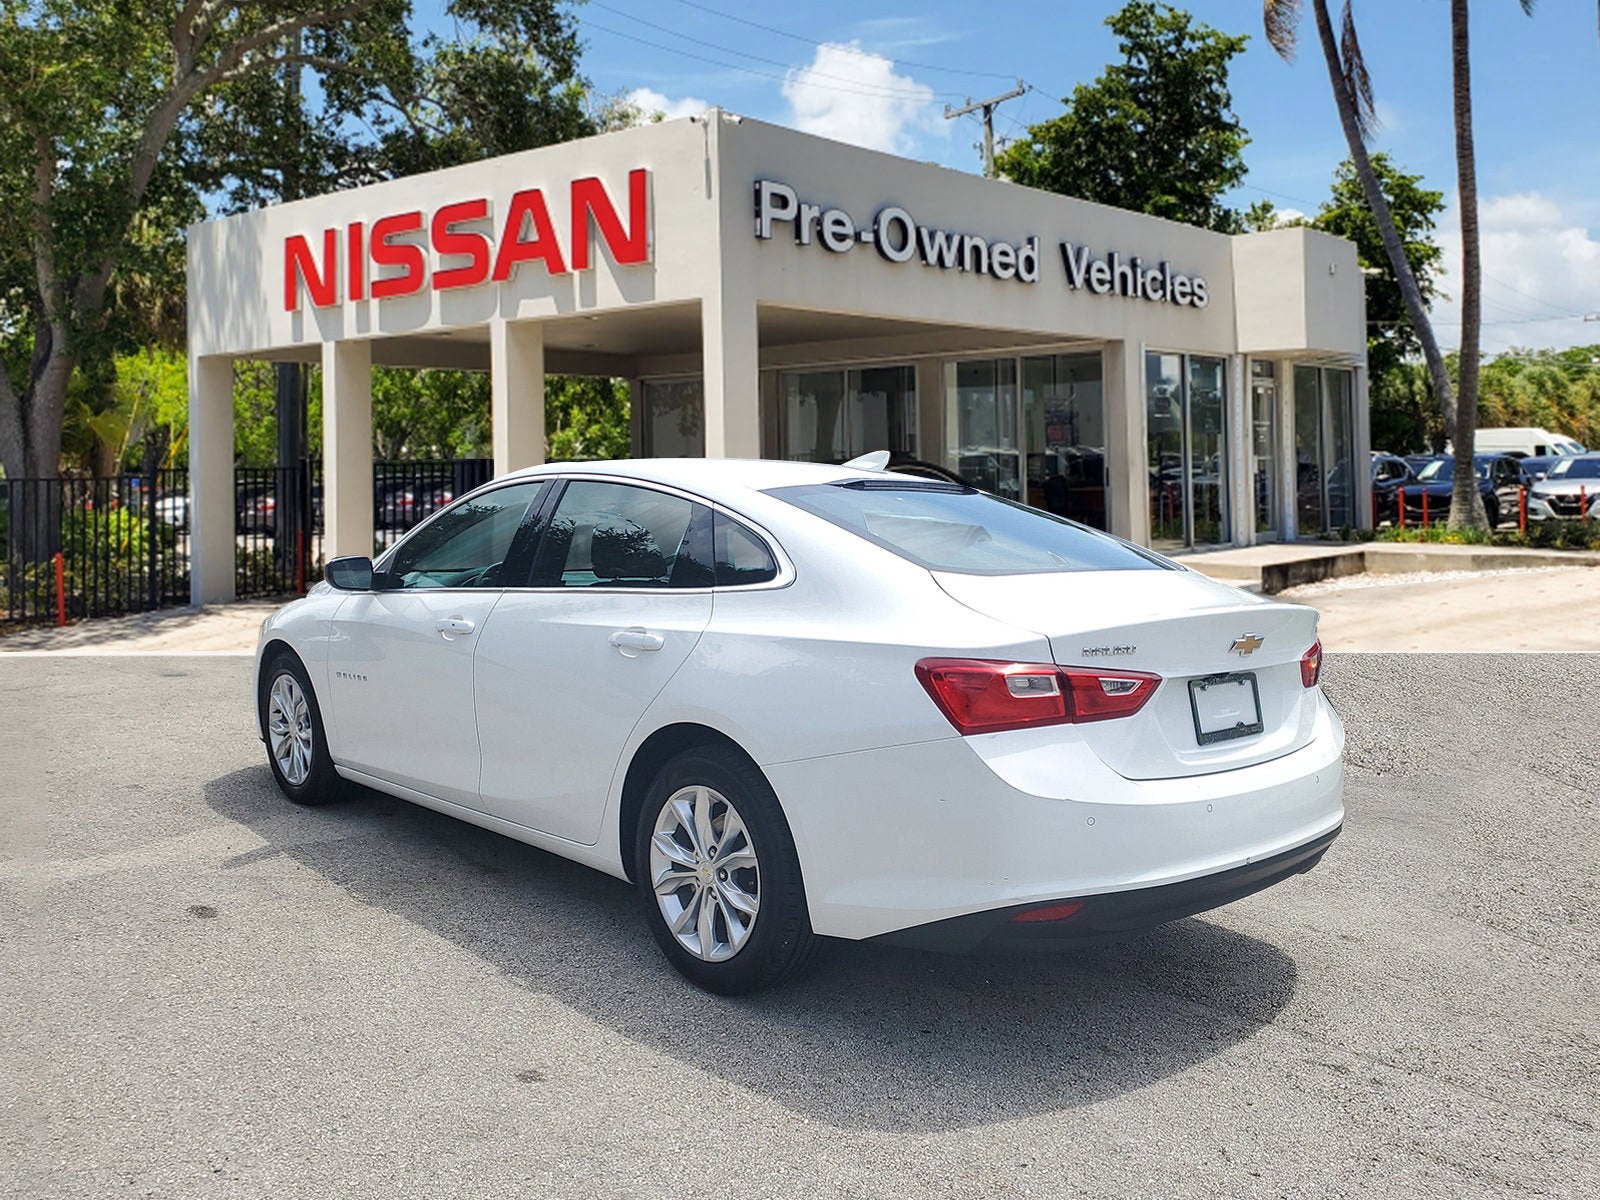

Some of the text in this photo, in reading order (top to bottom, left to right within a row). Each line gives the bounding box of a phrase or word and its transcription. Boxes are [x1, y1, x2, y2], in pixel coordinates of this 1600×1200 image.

[284, 168, 648, 312] NISSAN
[754, 179, 1209, 308] Pre-Owned Vehicles
